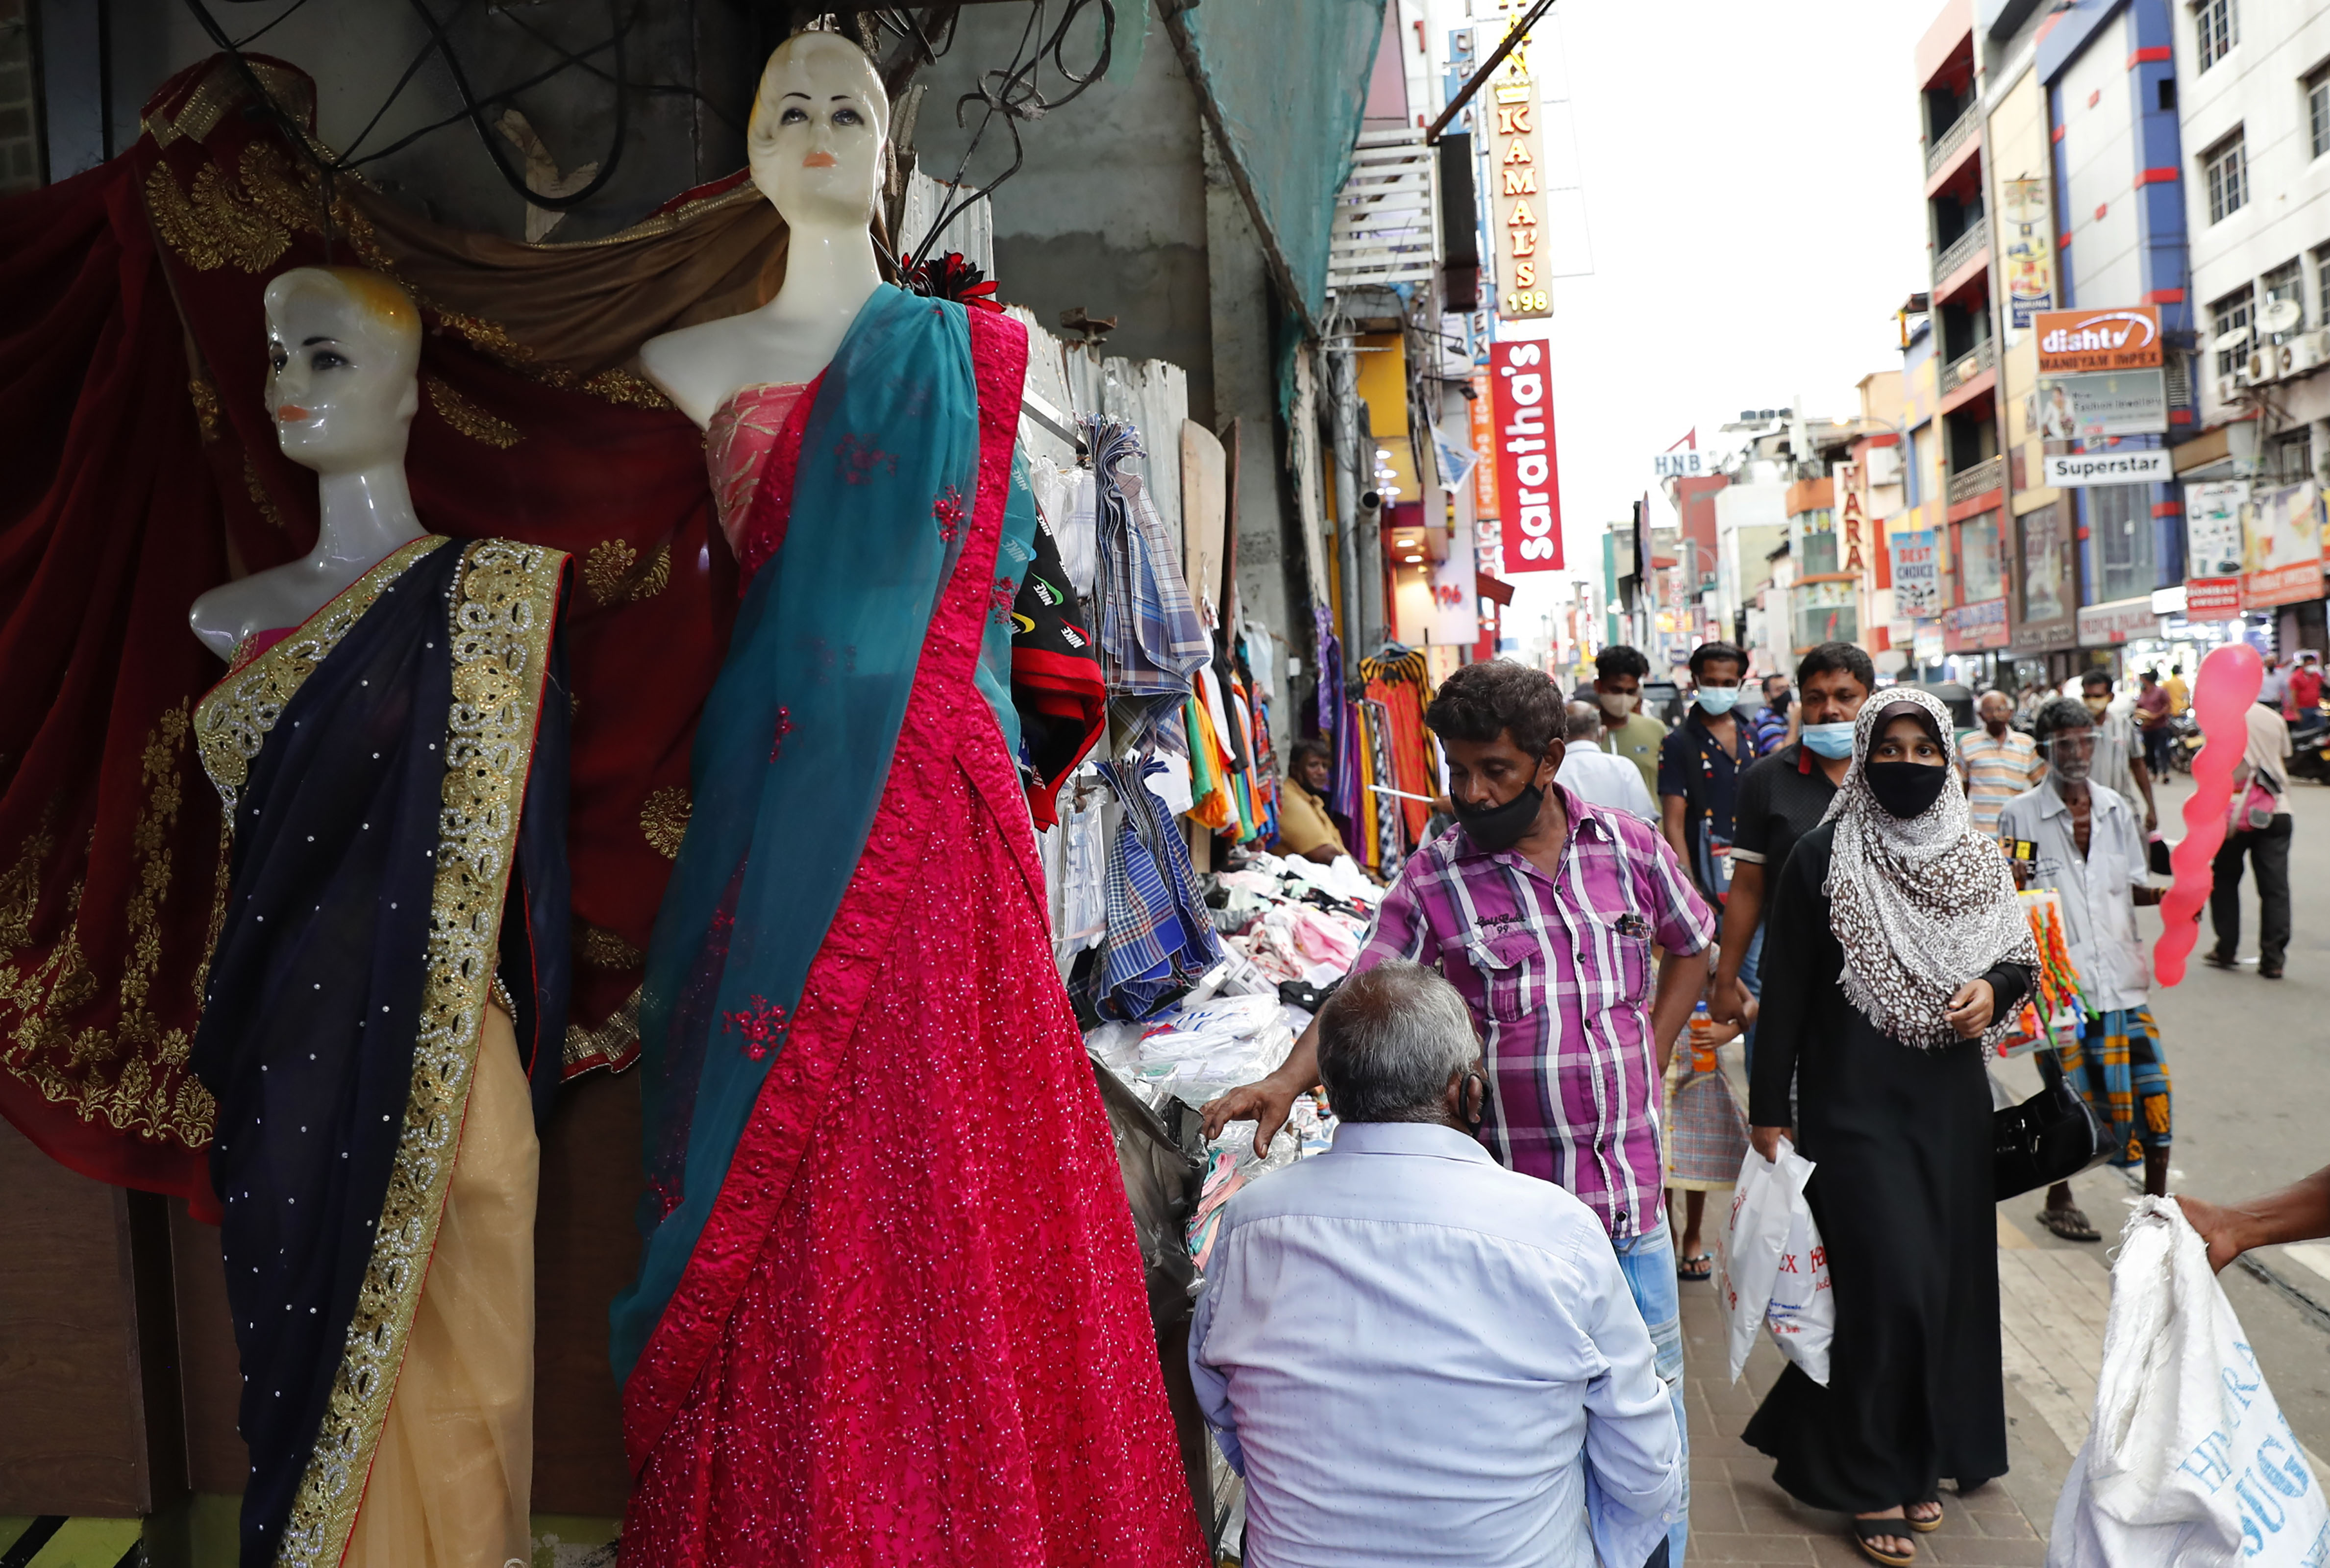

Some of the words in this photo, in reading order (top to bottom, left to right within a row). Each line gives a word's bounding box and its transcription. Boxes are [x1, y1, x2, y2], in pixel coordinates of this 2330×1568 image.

[1498, 106, 1537, 288] KAMAL'S
[1508, 290, 1548, 311] 198
[1501, 344, 1554, 560] saratha's
[1655, 455, 1700, 474] HNB
[2057, 458, 2159, 479] Superstar
[1036, 514, 1052, 537] NIKE
[1001, 540, 1027, 562] NIKE
[1899, 548, 1931, 563] BEST
[1033, 582, 1053, 606] NIKE
[1432, 585, 1462, 605] 196
[1061, 626, 1085, 649] NIKE
[1497, 924, 1509, 934] 99
